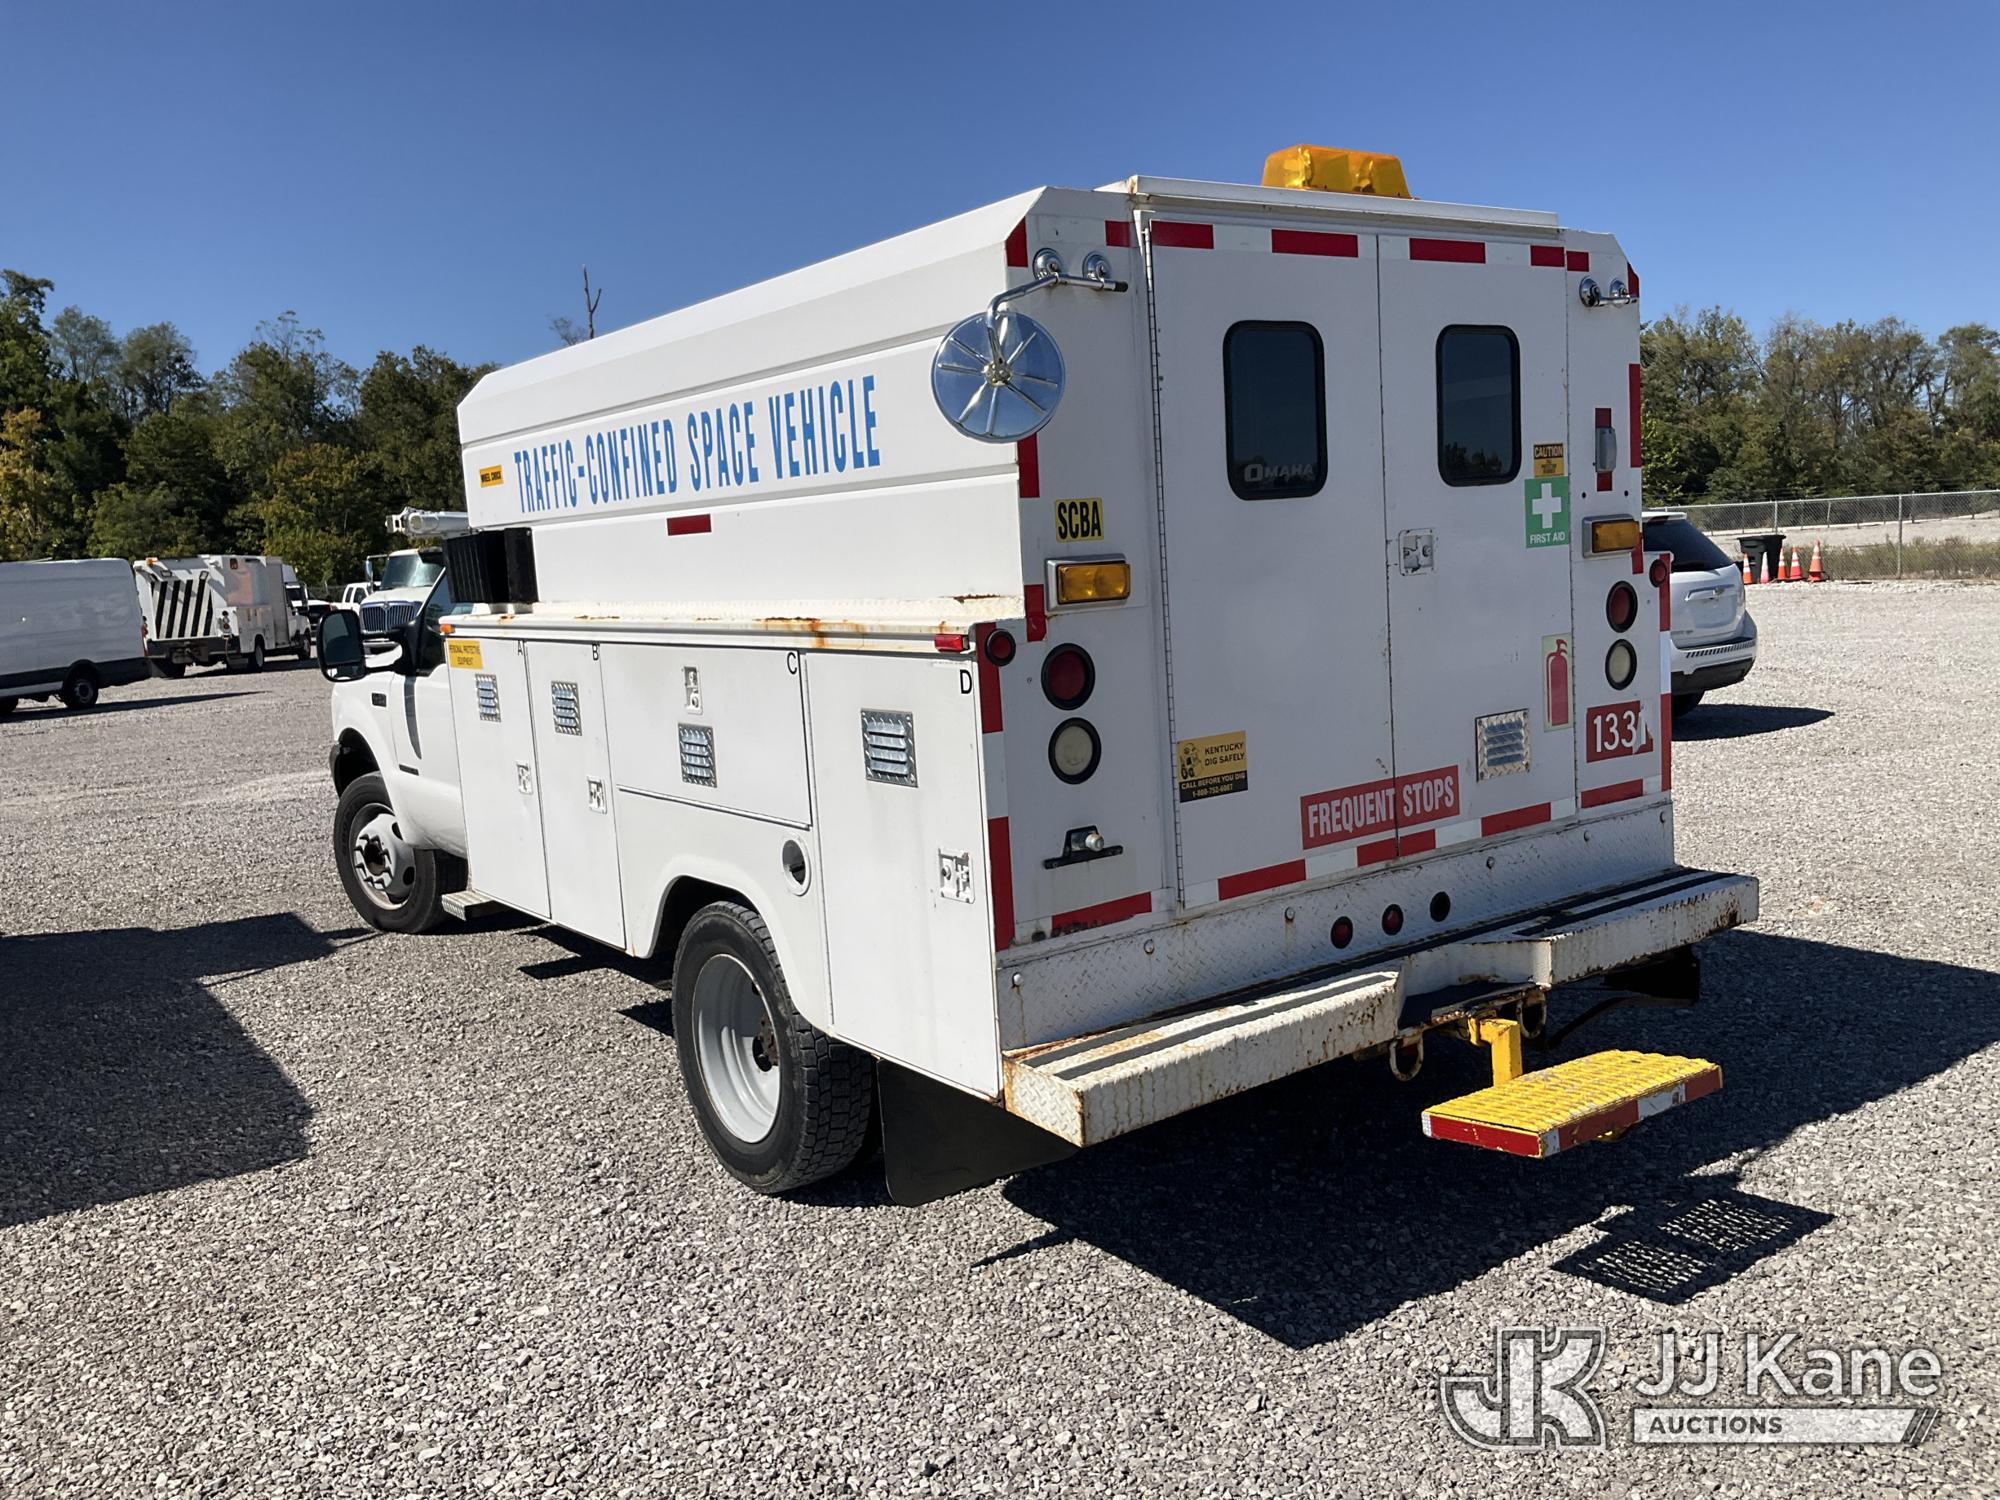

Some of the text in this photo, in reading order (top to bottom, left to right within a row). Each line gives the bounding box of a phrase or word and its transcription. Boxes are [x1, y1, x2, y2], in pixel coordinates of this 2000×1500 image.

[514, 375, 881, 513] TRAFFIC-CONFINED SPACE VEHICLE
[1535, 446, 1563, 458] CAUTION
[1057, 501, 1101, 539] SCBA
[1530, 532, 1566, 544] FIRST AID
[517, 641, 523, 656] A
[592, 643, 599, 661] B
[787, 652, 798, 675] C
[960, 669, 972, 694] D
[1205, 742, 1244, 755] KENTUCKY
[1205, 752, 1245, 766] DIG SAFELY
[1181, 781, 1197, 789] CALL
[1198, 777, 1221, 786] BEFORE
[1222, 774, 1234, 783] YOU
[1308, 776, 1454, 838] FREQUENT STOPS
